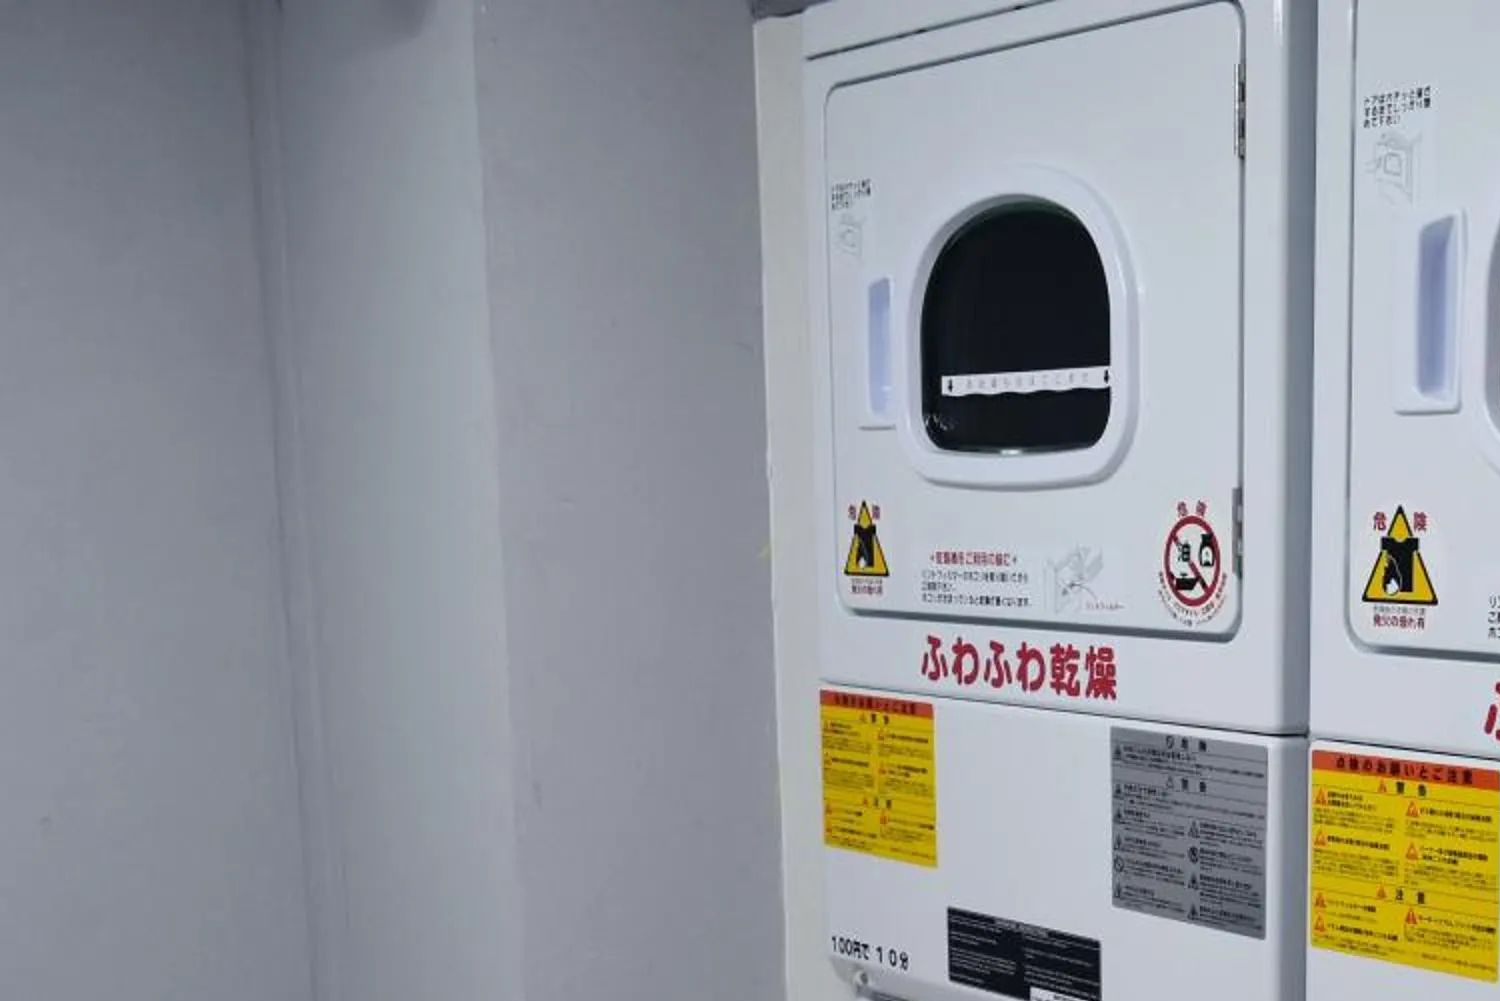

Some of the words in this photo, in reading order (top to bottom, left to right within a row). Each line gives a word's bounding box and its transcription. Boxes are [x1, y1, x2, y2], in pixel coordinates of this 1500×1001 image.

[922, 635, 1116, 699] ふわふわ乾燥
